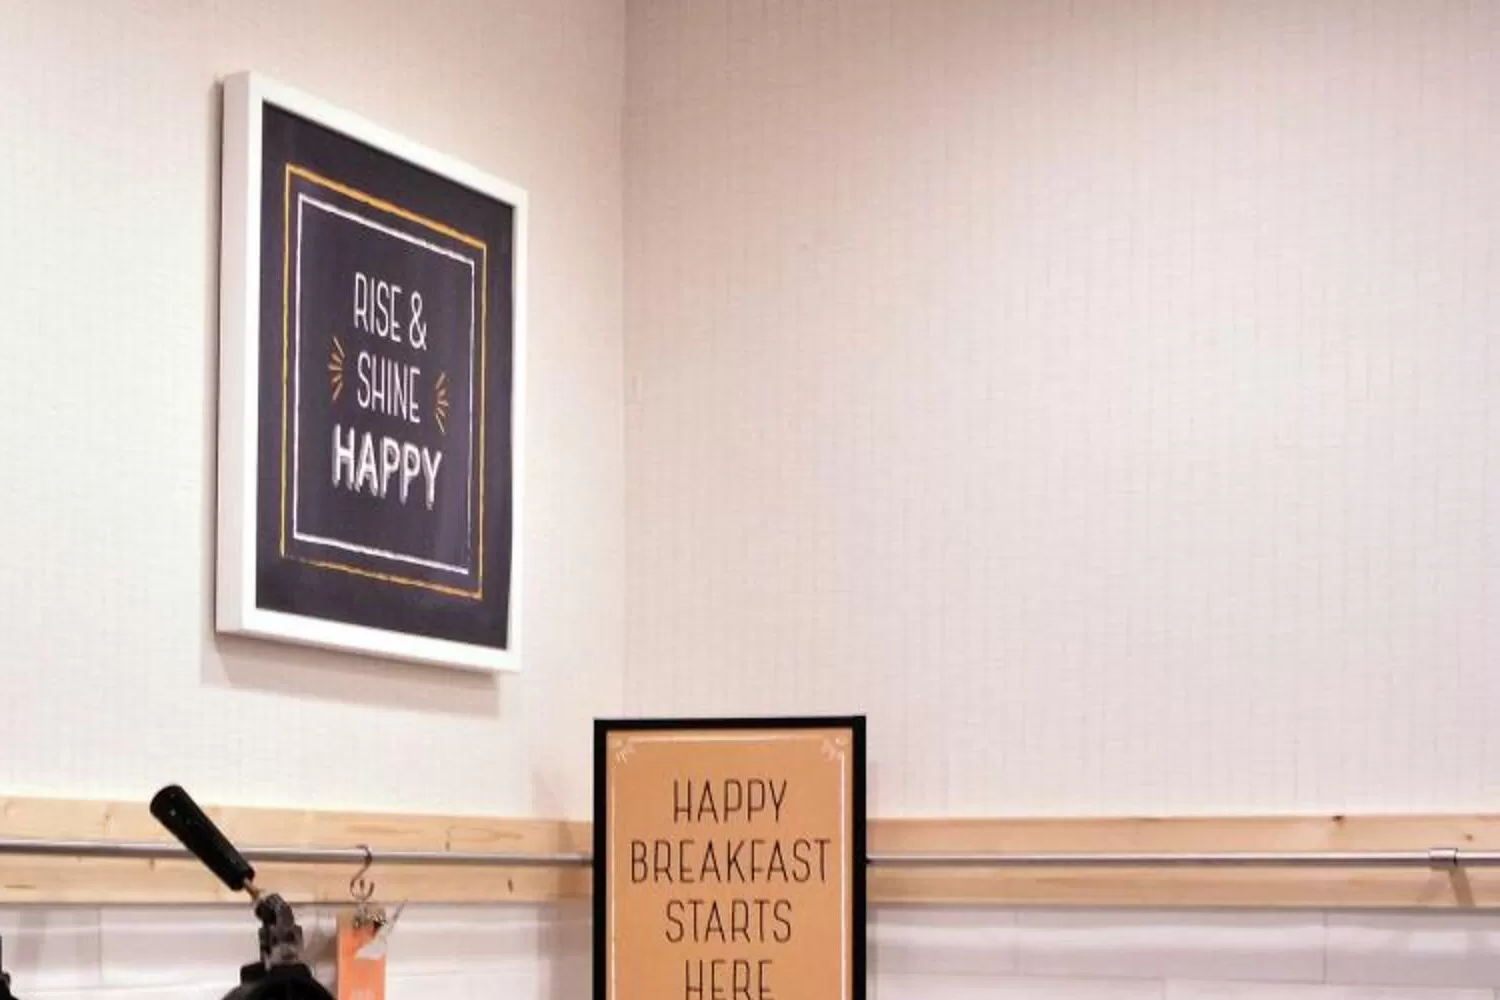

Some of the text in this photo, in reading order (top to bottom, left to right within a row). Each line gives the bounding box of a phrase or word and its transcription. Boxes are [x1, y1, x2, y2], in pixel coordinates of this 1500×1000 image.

[353, 271, 427, 351] RISE &
[356, 350, 421, 424] SHINE
[331, 424, 442, 509] HAPPY
[672, 777, 788, 824] HAPPY
[630, 838, 831, 884] BREAKFAST
[664, 898, 793, 944] STARTS
